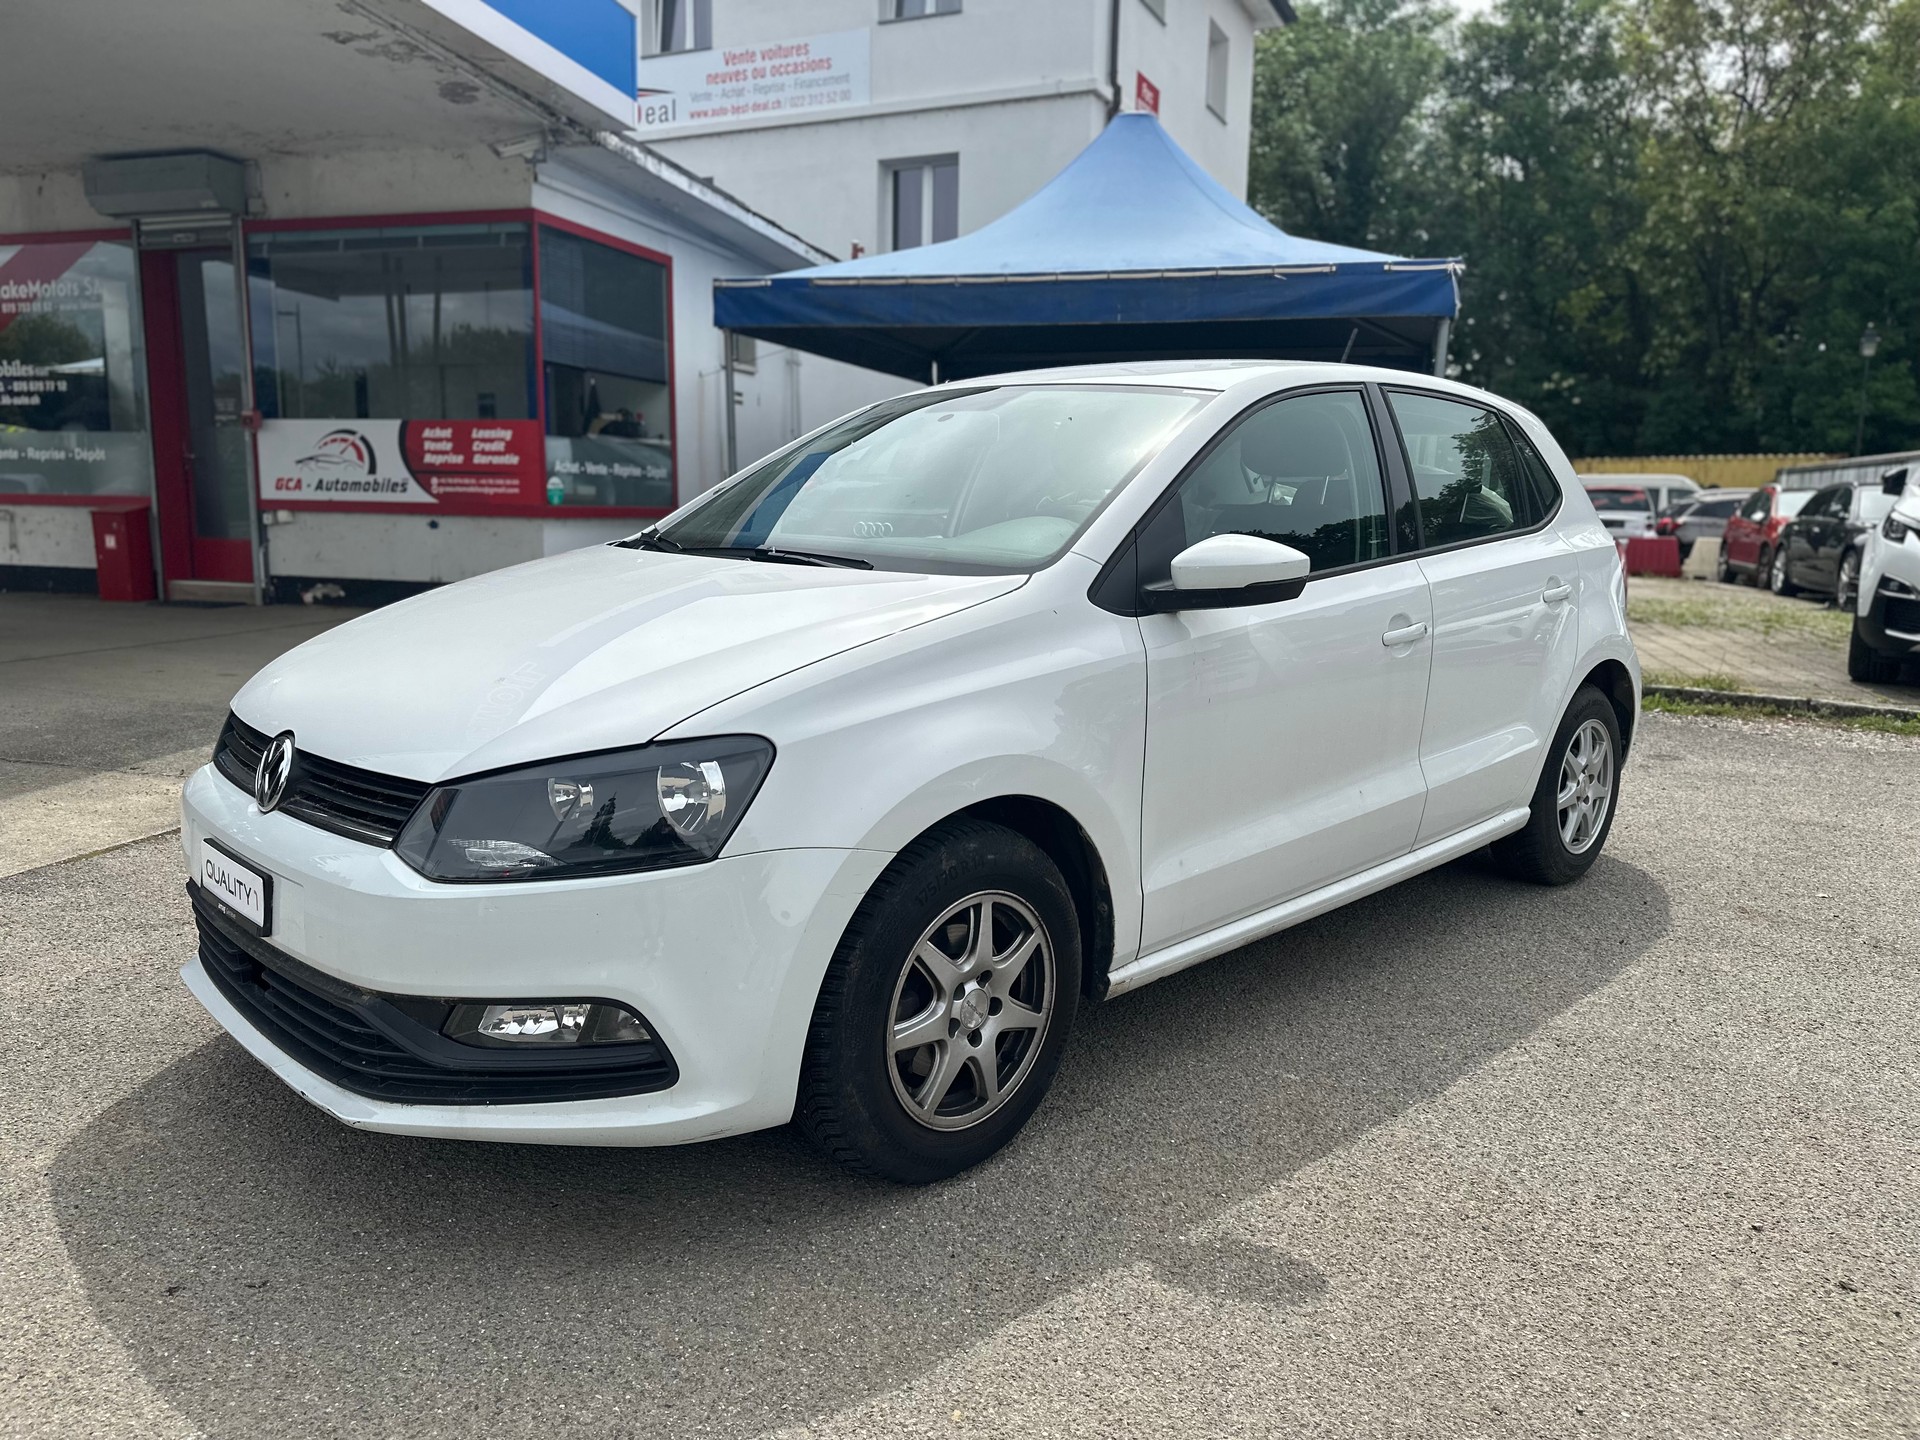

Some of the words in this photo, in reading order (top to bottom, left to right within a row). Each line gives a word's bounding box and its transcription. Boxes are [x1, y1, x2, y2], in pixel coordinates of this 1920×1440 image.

[723, 48, 756, 67] Vente
[760, 42, 810, 61] voitures
[706, 68, 748, 86] neuves
[751, 66, 767, 80] ou
[770, 56, 832, 77] occasions
[689, 90, 713, 103] Vente
[721, 86, 746, 99] Achat
[753, 81, 786, 97] Reprise
[794, 73, 850, 90] Financement
[421, 427, 453, 439] Achat
[471, 427, 513, 441] Leasing
[423, 440, 453, 451] Vente
[27, 447, 66, 463] Reprise
[423, 452, 465, 466] Reprise
[472, 452, 520, 465] Garantie
[554, 459, 580, 475] Achat
[275, 477, 303, 491] GCA
[314, 477, 409, 493] Automobiles
